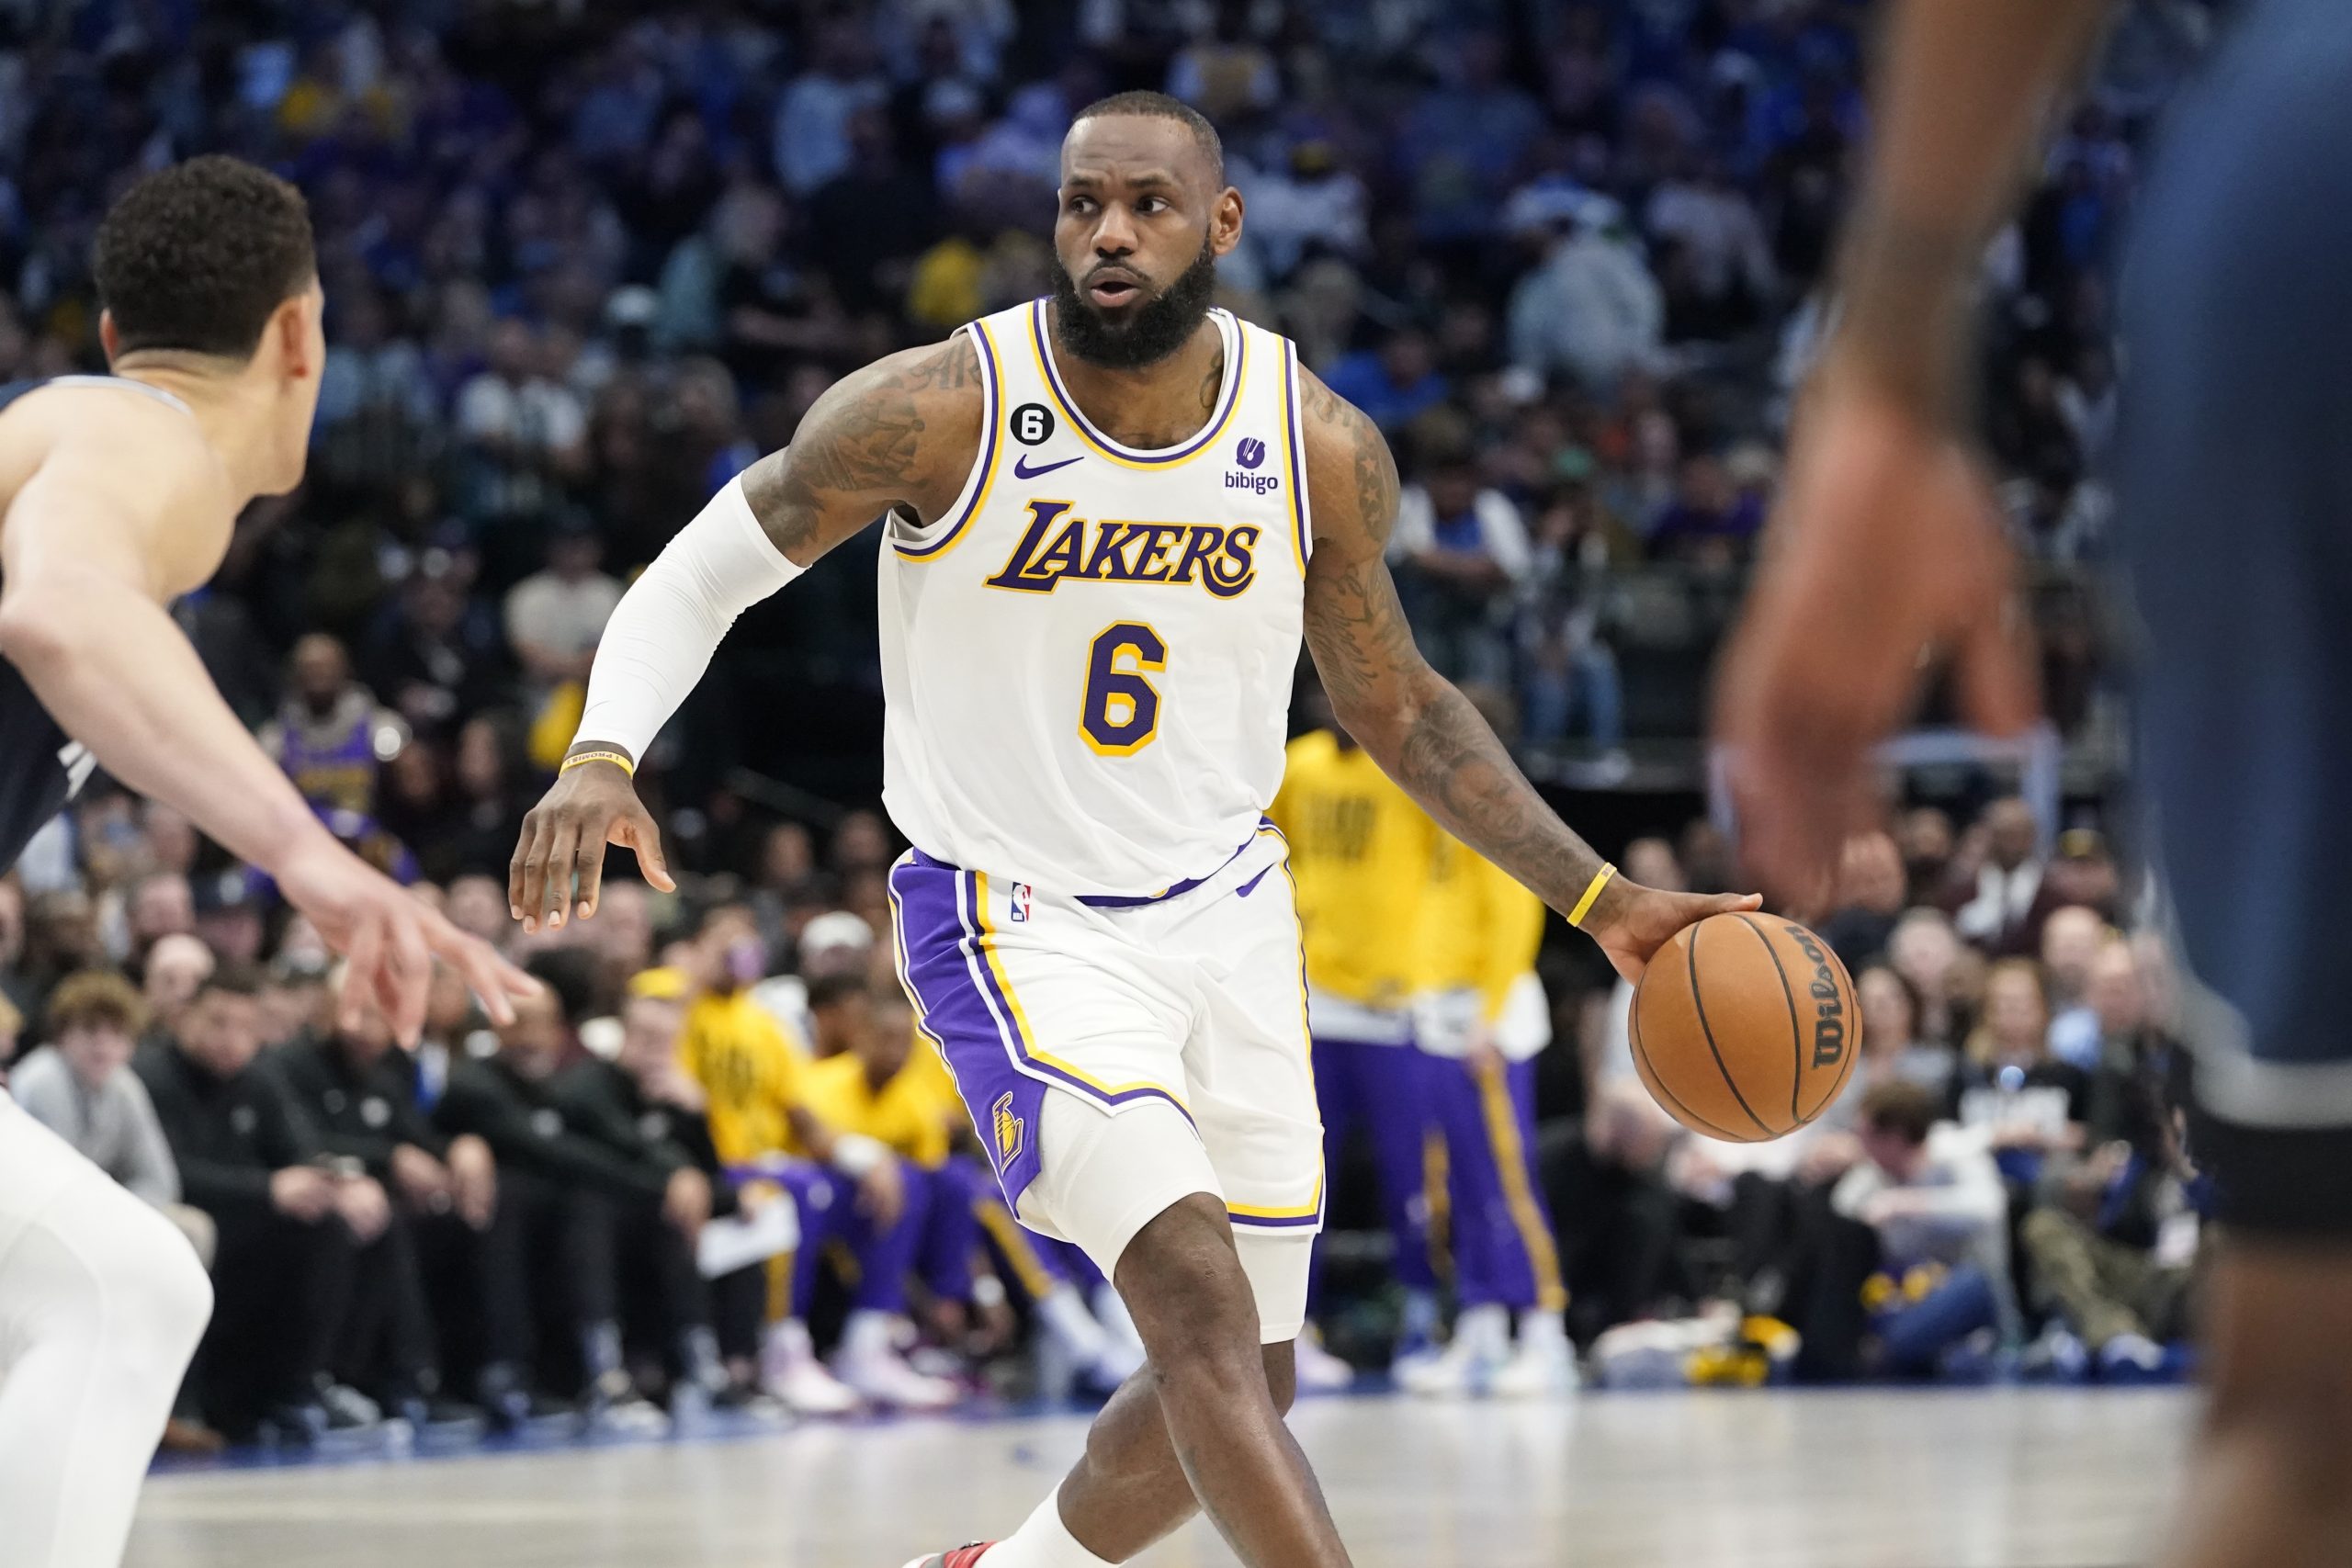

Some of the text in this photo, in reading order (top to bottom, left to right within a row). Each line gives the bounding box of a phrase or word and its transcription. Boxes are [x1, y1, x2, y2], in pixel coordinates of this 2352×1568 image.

[1021, 409, 1044, 440] 6
[1225, 470, 1278, 495] bibigo
[981, 498, 1263, 600] LAKERS
[1078, 620, 1169, 758] 6
[1783, 926, 1844, 1069] Wilson
